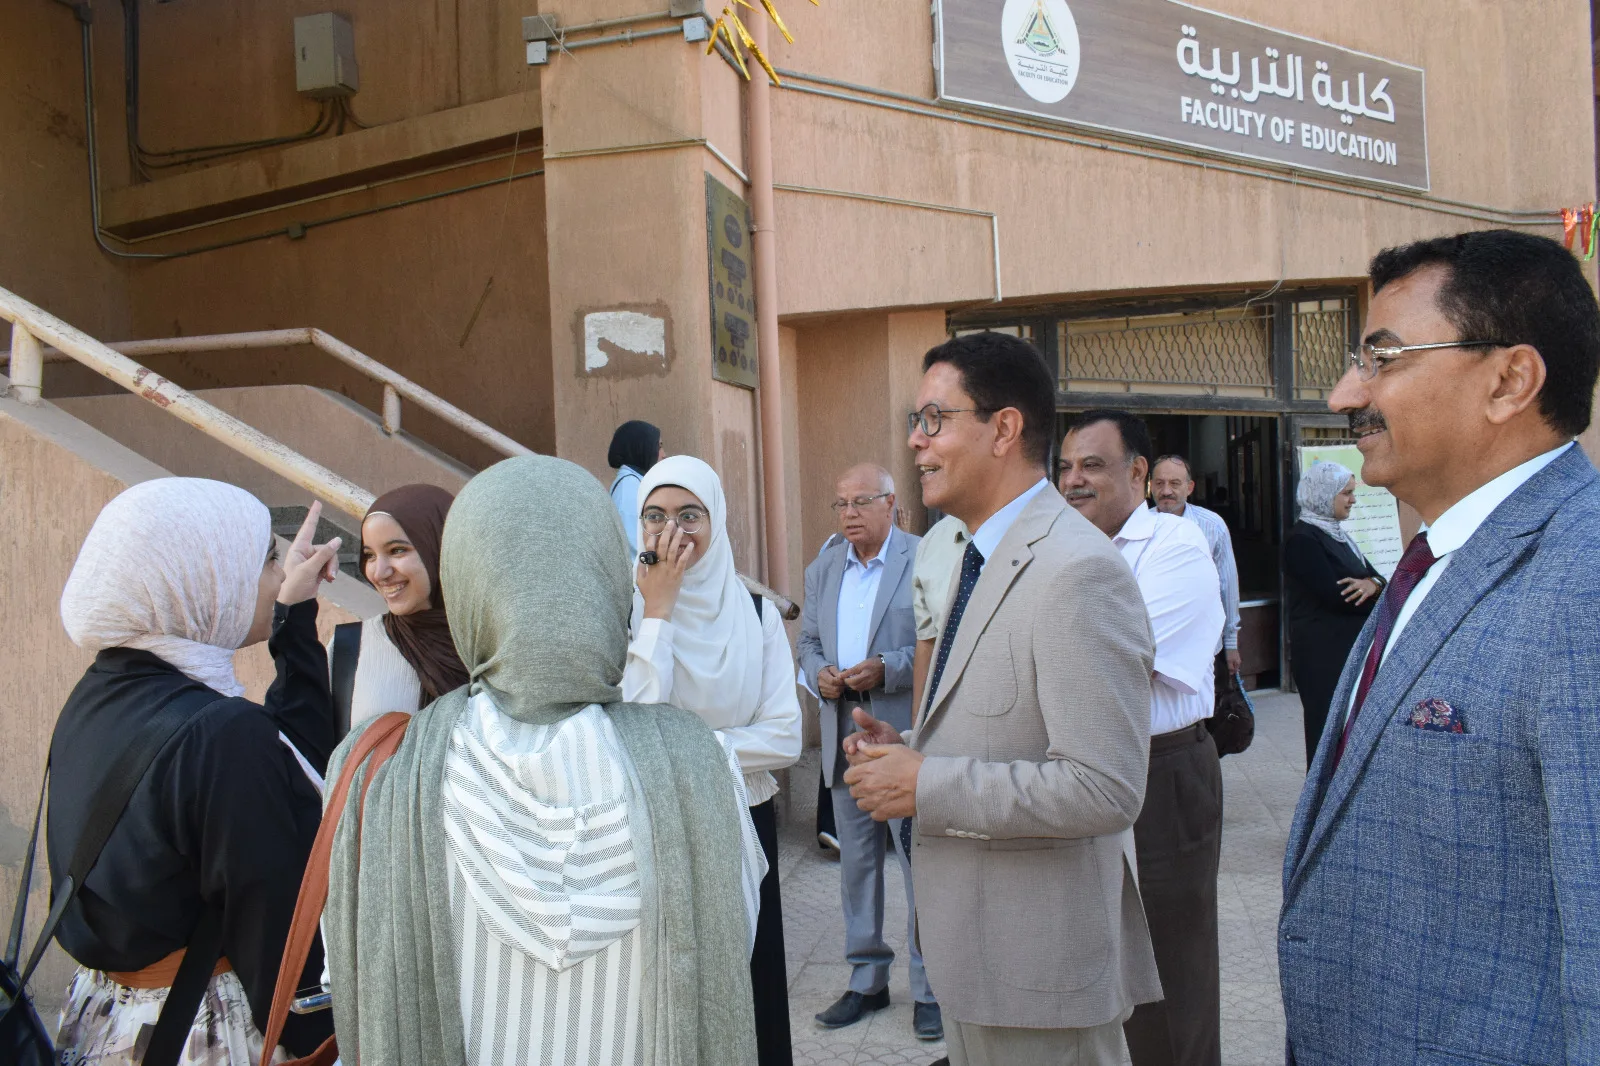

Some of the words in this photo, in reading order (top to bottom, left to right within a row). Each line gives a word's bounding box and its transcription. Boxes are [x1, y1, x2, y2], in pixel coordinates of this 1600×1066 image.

[1018, 70, 1036, 79] FACULTY
[1043, 75, 1069, 86] EDUCATION
[1176, 24, 1304, 102] التربية
[1312, 60, 1395, 125] كلية
[1180, 95, 1266, 139] FACULTY
[1270, 116, 1295, 144] OF
[1301, 122, 1397, 166] EDUCATION
